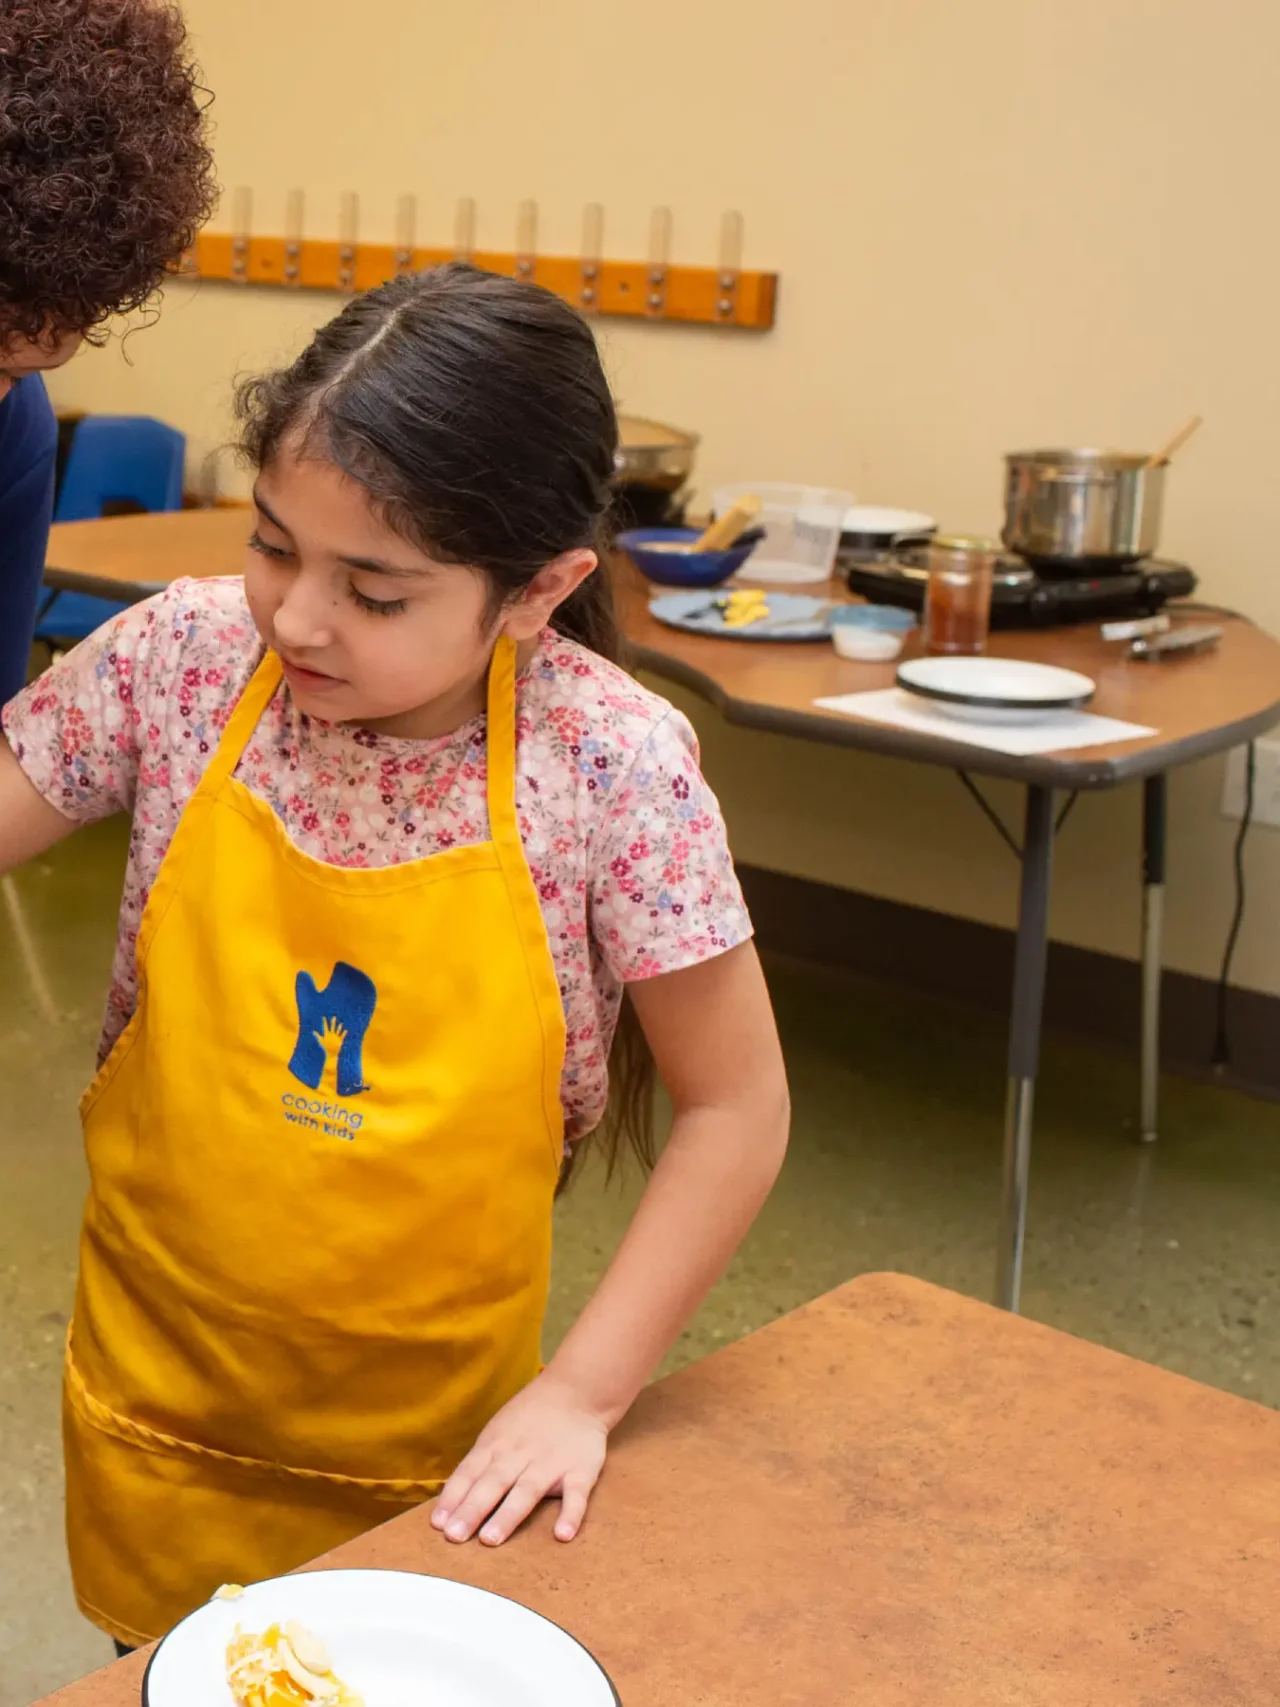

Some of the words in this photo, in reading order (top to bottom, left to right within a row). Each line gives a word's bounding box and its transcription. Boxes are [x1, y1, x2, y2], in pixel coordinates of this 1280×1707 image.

[281, 1093, 363, 1129] cooking
[284, 1111, 319, 1130] with
[323, 1121, 355, 1140] kids
